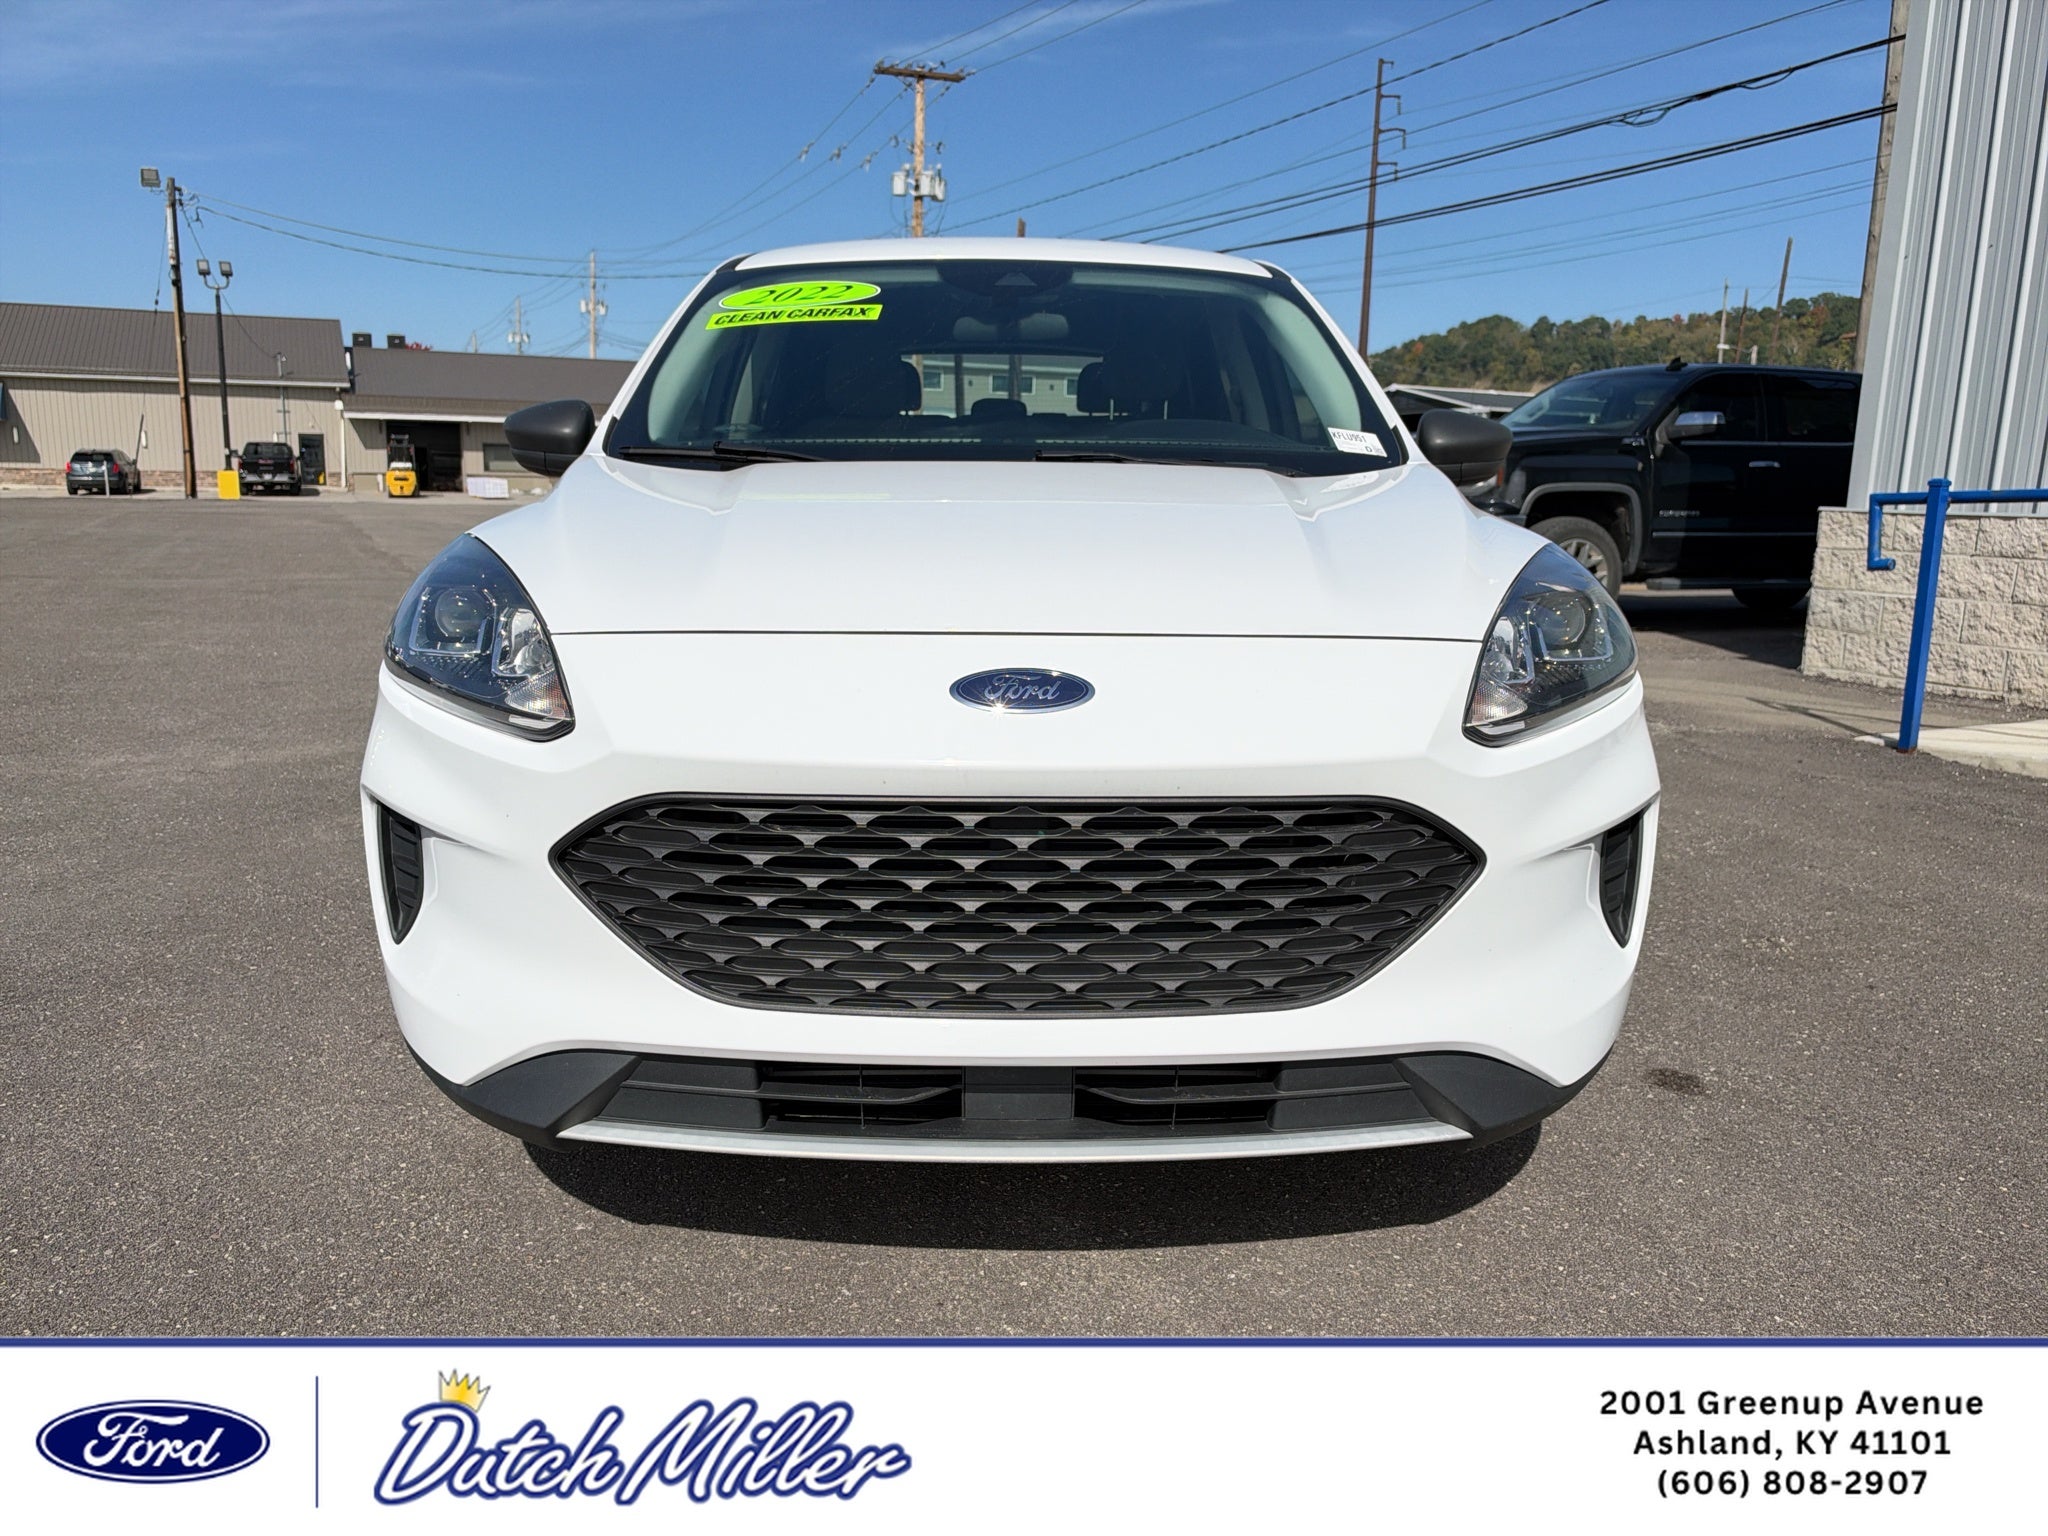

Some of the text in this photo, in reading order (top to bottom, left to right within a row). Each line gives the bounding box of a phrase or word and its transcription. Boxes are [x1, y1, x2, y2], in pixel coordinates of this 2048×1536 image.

[743, 285, 854, 306] 2022
[714, 306, 871, 326] CLEAN CARFAX
[984, 675, 1062, 700] Ford
